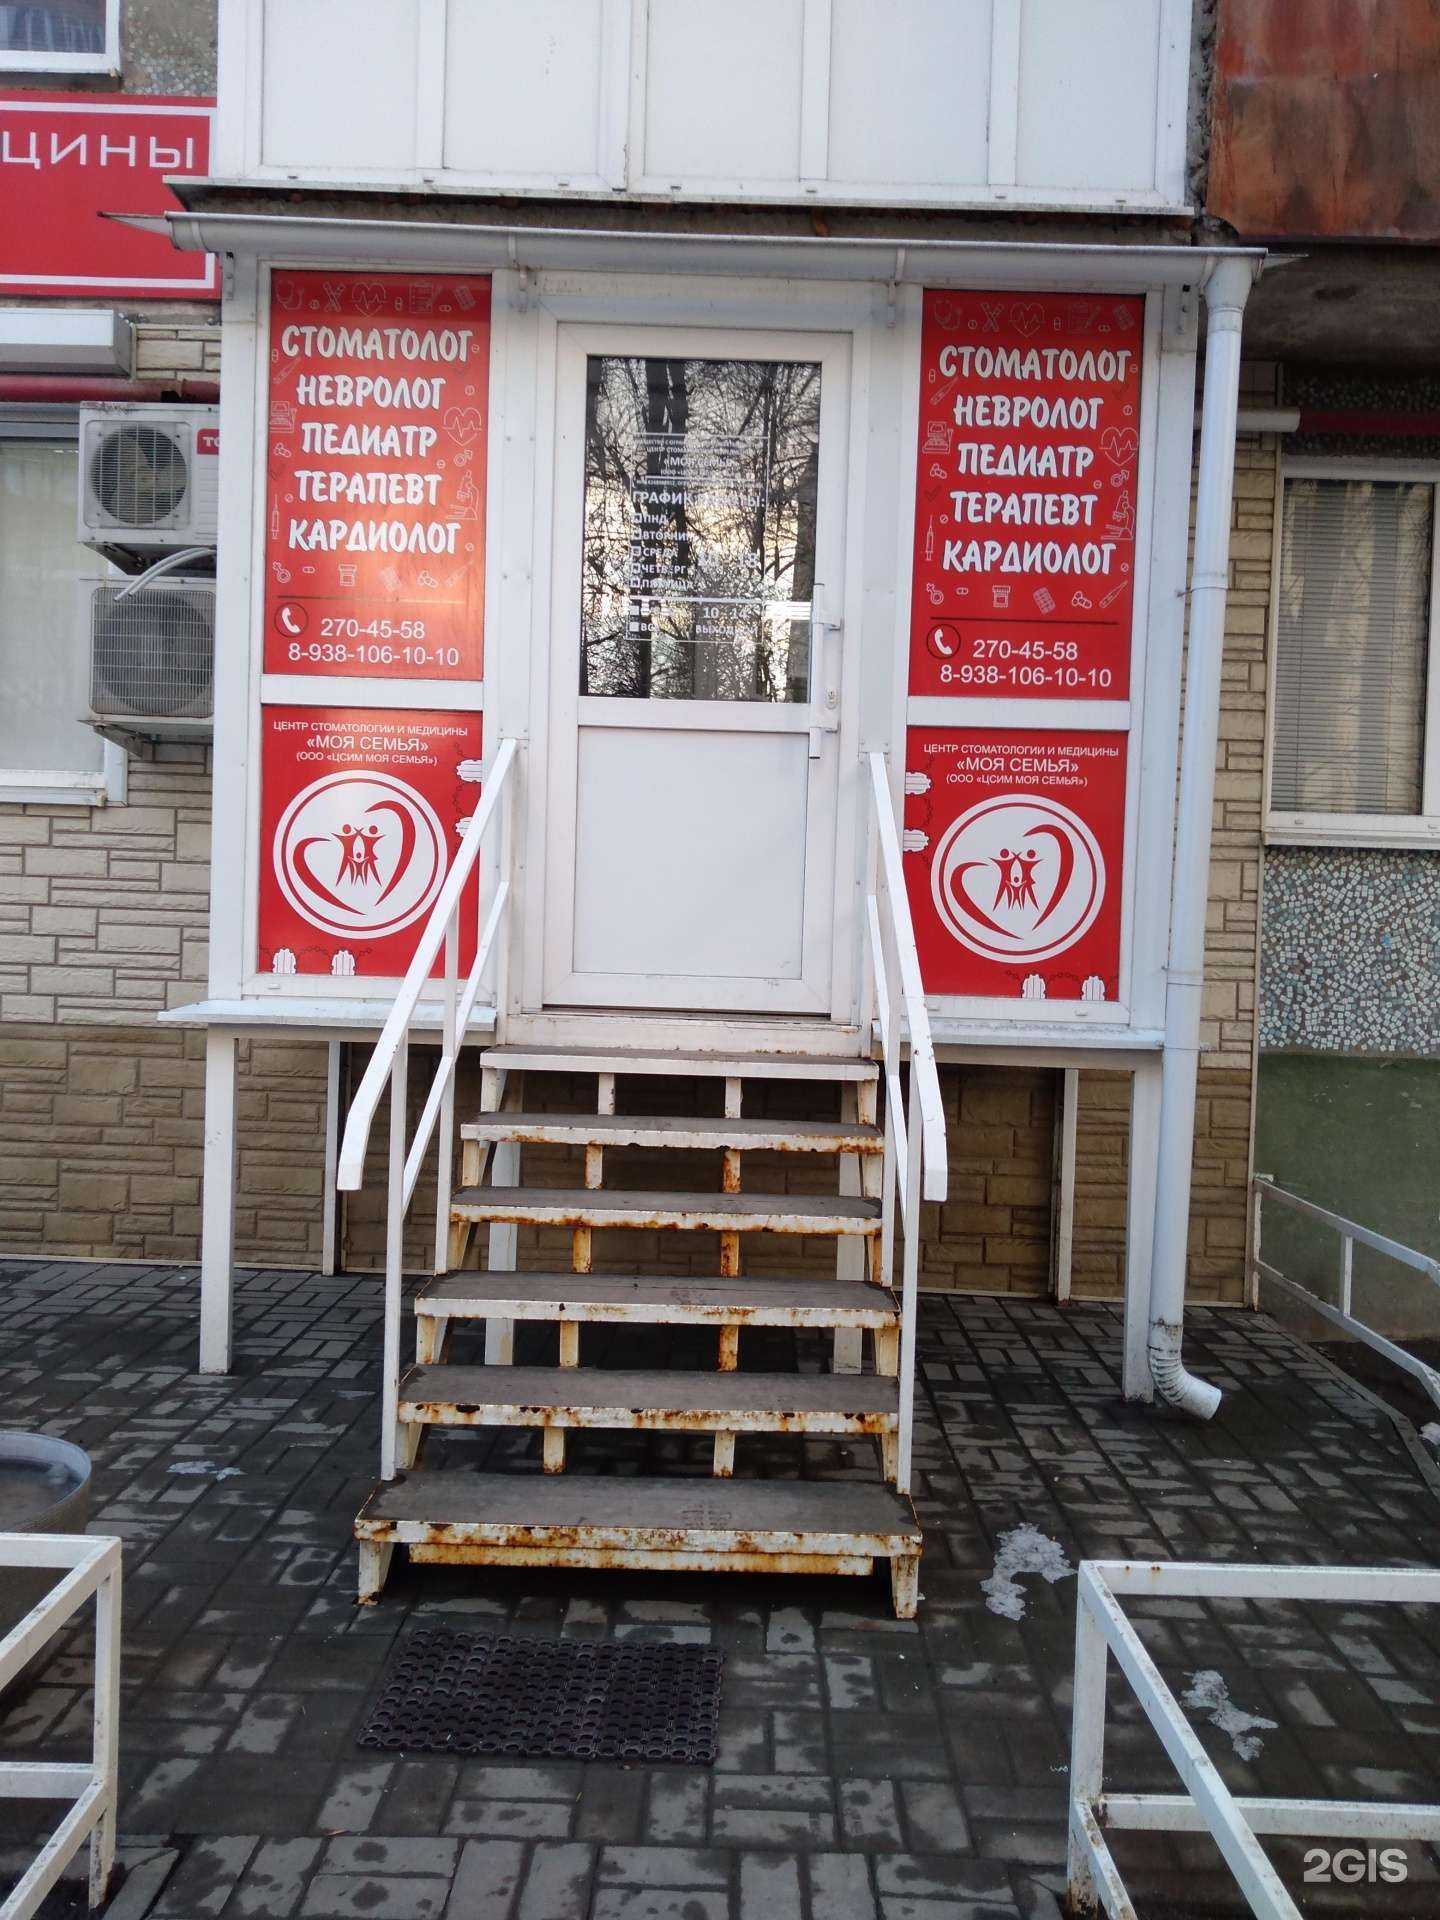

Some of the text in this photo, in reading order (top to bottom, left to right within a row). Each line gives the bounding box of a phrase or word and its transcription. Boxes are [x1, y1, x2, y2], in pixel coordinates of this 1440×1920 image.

[2, 130, 194, 170] ЦИНЫ
[281, 325, 473, 362] СТОМАТОЛОГ
[939, 345, 1131, 382] СТОМАТОЛОГ
[296, 374, 446, 409] НЕВРОЛОГ
[953, 394, 1104, 430] НЕВРОЛОГ
[301, 422, 437, 457] ПЕДИАТР
[957, 443, 1094, 478] ПЕДИАТР
[294, 470, 442, 506] ТЕРАПЕВТ
[632, 490, 694, 507] ГРАФИК
[950, 491, 1098, 527] ТЕРАПЕВТ
[288, 518, 461, 553] КАРДИОЛОГ
[942, 539, 1116, 575] КАРДИОЛОГ
[321, 617, 425, 639] 270-45-58
[288, 643, 459, 666] 8-938-106-10-10
[973, 639, 1078, 661] 270-45-58
[940, 665, 1112, 687] 8-938-106-10-10
[273, 721, 468, 737] ЦЕНТР СТОМАТОЛОГИИ И МЕДИЦИНЫ
[306, 735, 429, 751] «МОЯ СЕМЬЯ»
[296, 751, 438, 766] (ООО «ЦСИМ МОЯ СЕМЬЯ»)
[923, 743, 1119, 758] ЦЕНТР СТОМАТОЛОГИИ И МЕДИЦИНЫ
[956, 757, 1079, 773] «МОЯ СЕМЬЯ»
[946, 773, 1088, 787] (ООО «ЦСИМ МОЯ СЕМЬЯ»)
